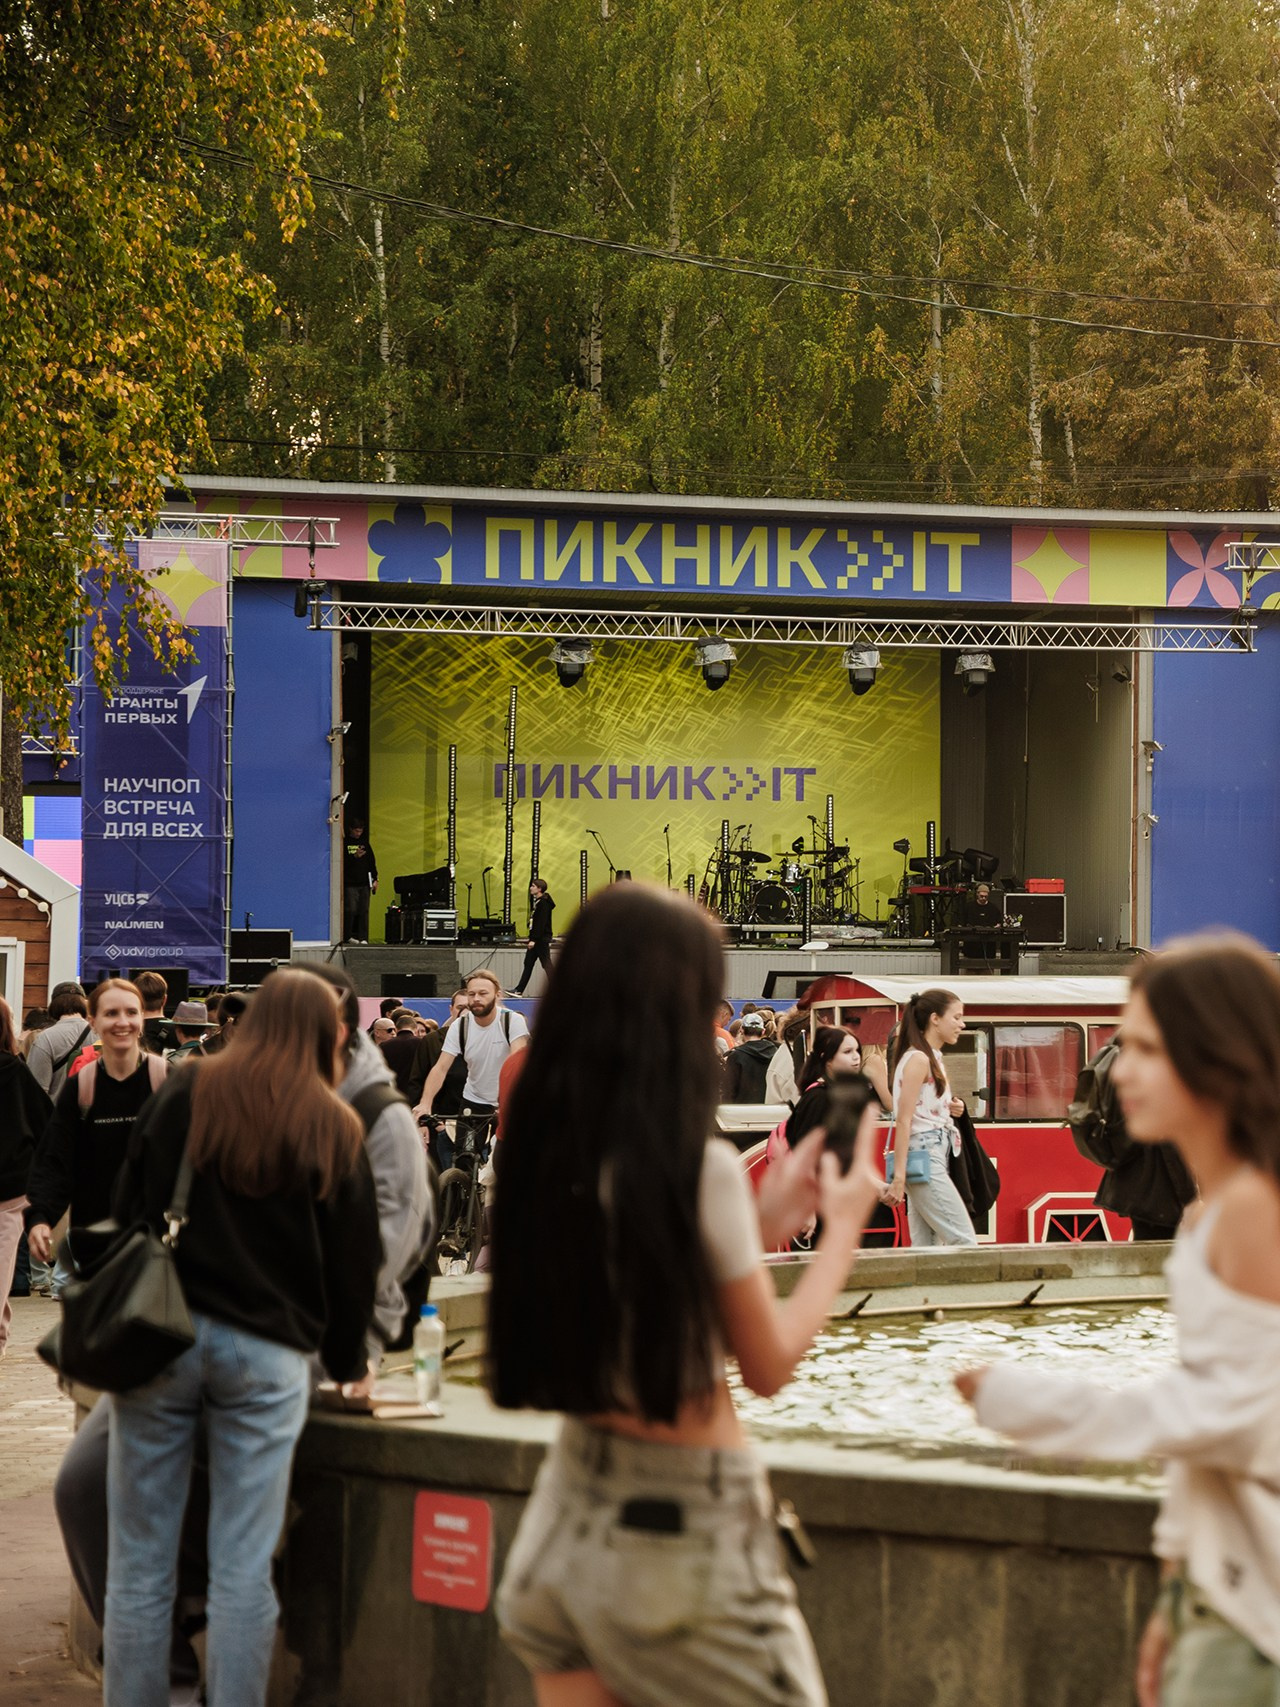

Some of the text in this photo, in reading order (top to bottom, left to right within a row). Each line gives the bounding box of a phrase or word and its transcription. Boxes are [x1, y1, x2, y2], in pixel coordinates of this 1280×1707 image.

[485, 517, 980, 593] ПИКНИК IT
[110, 697, 178, 709] ГРАНТЫ
[104, 712, 178, 724] ПЕРВЫХ
[104, 777, 200, 793] НАУЧПОП
[494, 763, 816, 801] ПИКНИК IT
[104, 800, 196, 815] ВСТРЕЧА
[103, 822, 204, 839] ДЛЯ ВСЕХ
[104, 893, 135, 907] УЦСБ
[104, 921, 164, 929] NAUMEN
